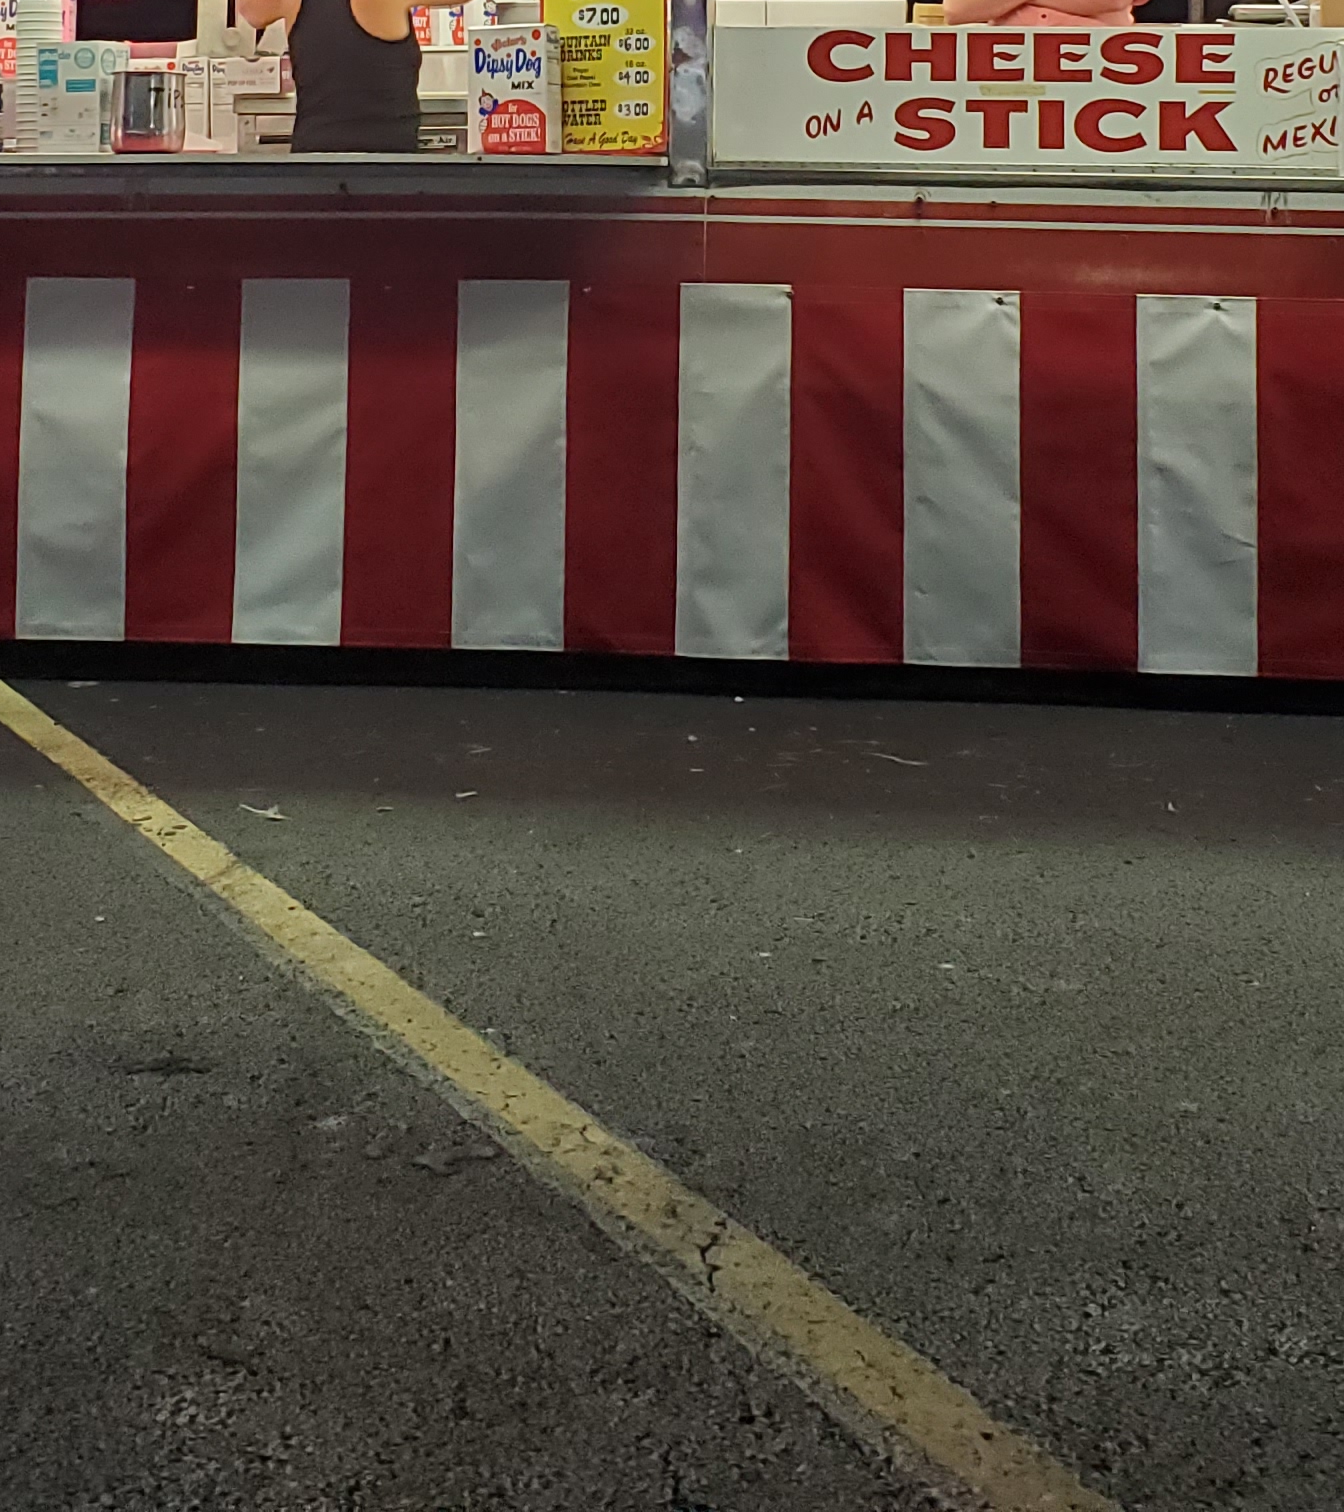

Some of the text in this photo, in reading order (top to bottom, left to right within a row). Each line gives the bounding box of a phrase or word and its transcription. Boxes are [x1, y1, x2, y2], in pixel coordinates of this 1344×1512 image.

[578, 7, 620, 26] $7.00
[560, 34, 611, 50] OUNTAIN
[475, 48, 542, 79] Dipsy Dog
[806, 29, 1237, 84] CHEESE
[1263, 50, 1338, 94] REGU
[510, 81, 534, 90] MIX
[562, 100, 607, 112] OTTLED
[492, 113, 540, 128] HOT DOGS
[804, 96, 1239, 154] ON A STICK
[509, 128, 541, 142] STICK!
[1262, 115, 1338, 155] MEXI
